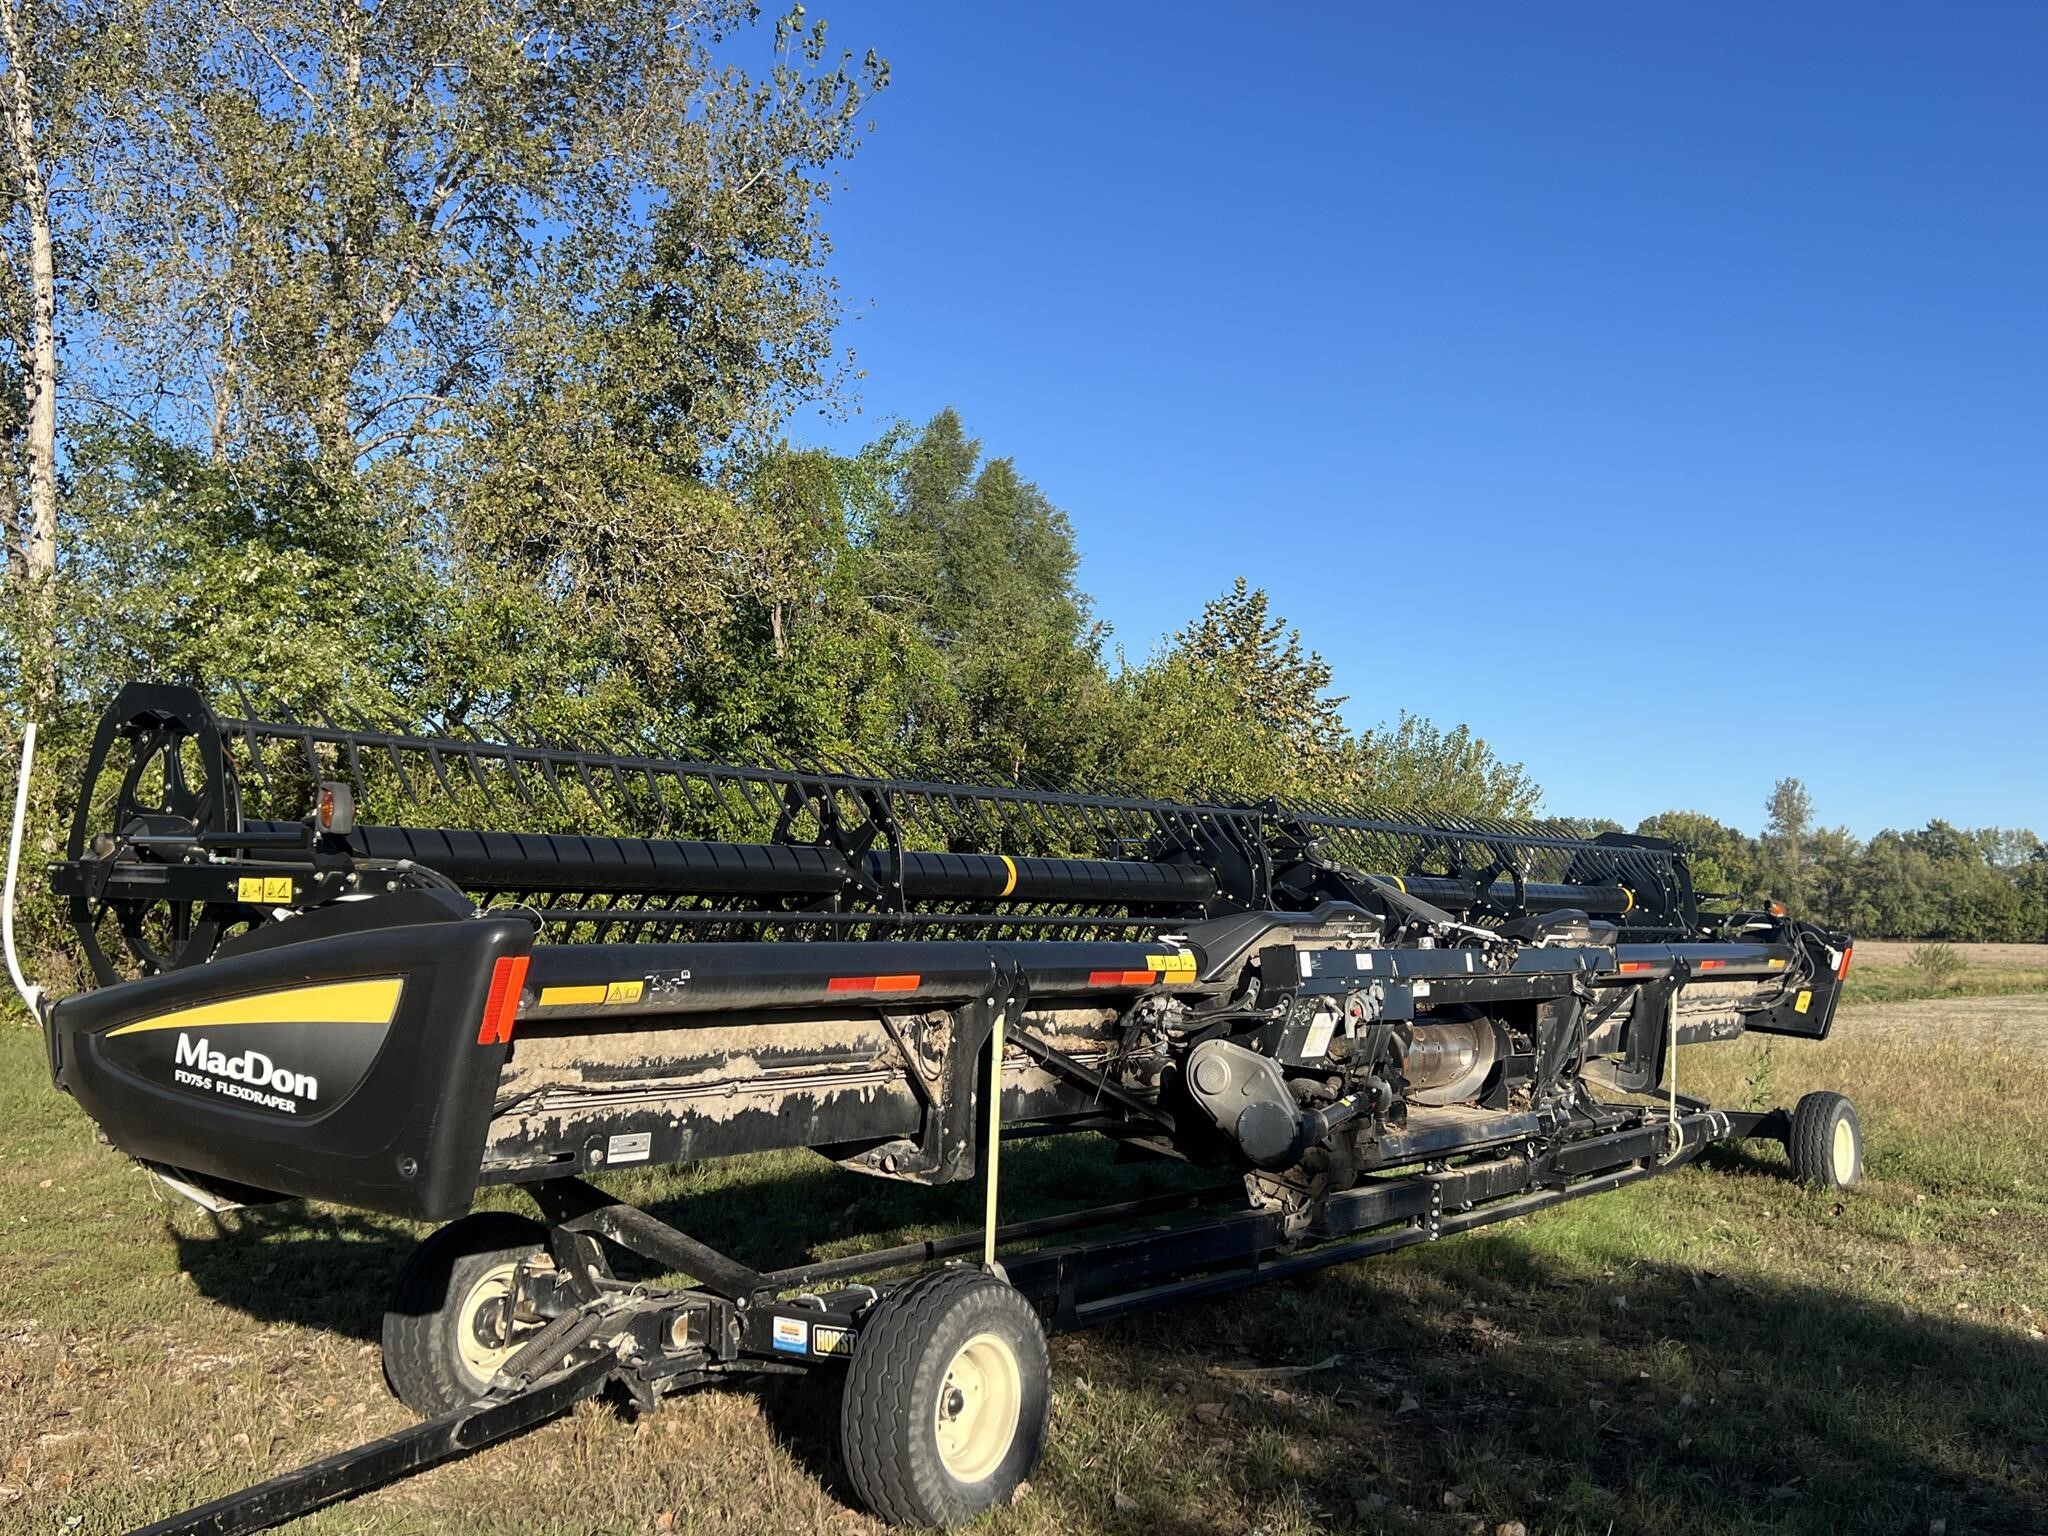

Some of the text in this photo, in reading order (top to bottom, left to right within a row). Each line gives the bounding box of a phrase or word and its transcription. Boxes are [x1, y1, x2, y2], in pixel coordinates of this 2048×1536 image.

[175, 1032, 318, 1100] MacDon
[174, 1069, 296, 1114] FD75-S FLEXDRAPER
[816, 1329, 856, 1354] HORST
